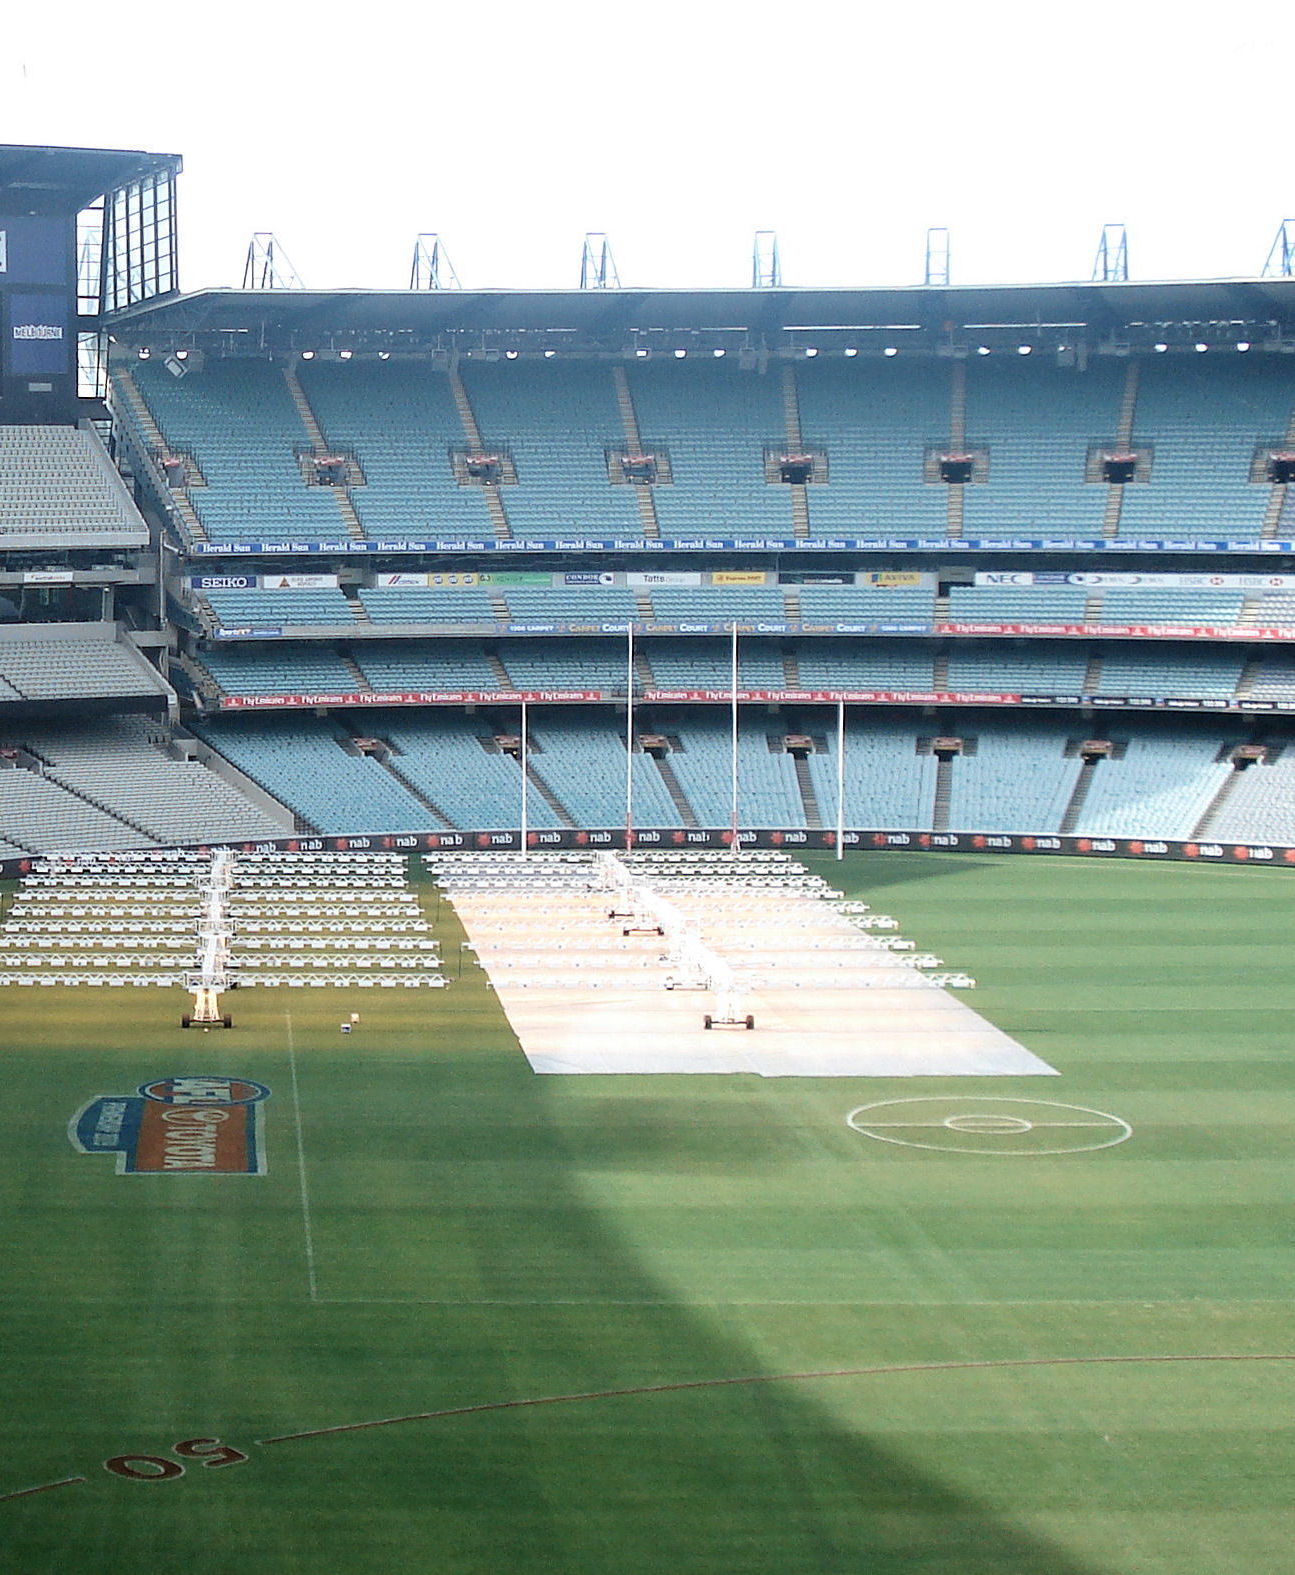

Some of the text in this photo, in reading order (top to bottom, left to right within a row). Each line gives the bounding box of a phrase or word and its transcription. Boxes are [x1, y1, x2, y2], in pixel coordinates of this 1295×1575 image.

[13, 324, 63, 340] MELBOURNE
[203, 543, 232, 553] Herald
[261, 543, 290, 552] Herald
[319, 542, 348, 552] Herald
[378, 542, 407, 551] Herald
[495, 541, 525, 550] Herald
[555, 540, 584, 549] Herald
[615, 540, 644, 549] Herald
[674, 540, 704, 549] Herald
[201, 577, 247, 588] SEIKO
[986, 575, 1021, 583] NEC
[602, 624, 629, 632] COURT
[679, 623, 708, 632] COURT
[758, 624, 787, 632] COURT
[836, 624, 866, 632] COURT
[397, 836, 418, 847] nab
[440, 834, 463, 845] nab
[490, 833, 513, 844] nab
[540, 832, 561, 843] nab
[590, 832, 612, 842] nab
[639, 831, 660, 842] nab
[785, 832, 807, 843] nab
[887, 834, 910, 845] nab
[934, 834, 959, 846] nab
[987, 835, 1012, 847] nab
[256, 842, 276, 852] nab
[300, 839, 322, 851] nab
[349, 838, 370, 848] nab
[1036, 837, 1062, 849] nab
[1092, 839, 1116, 852] nab
[1144, 841, 1169, 854] nab
[163, 1124, 218, 1169] TOYOTA
[103, 1437, 249, 1481] 50
